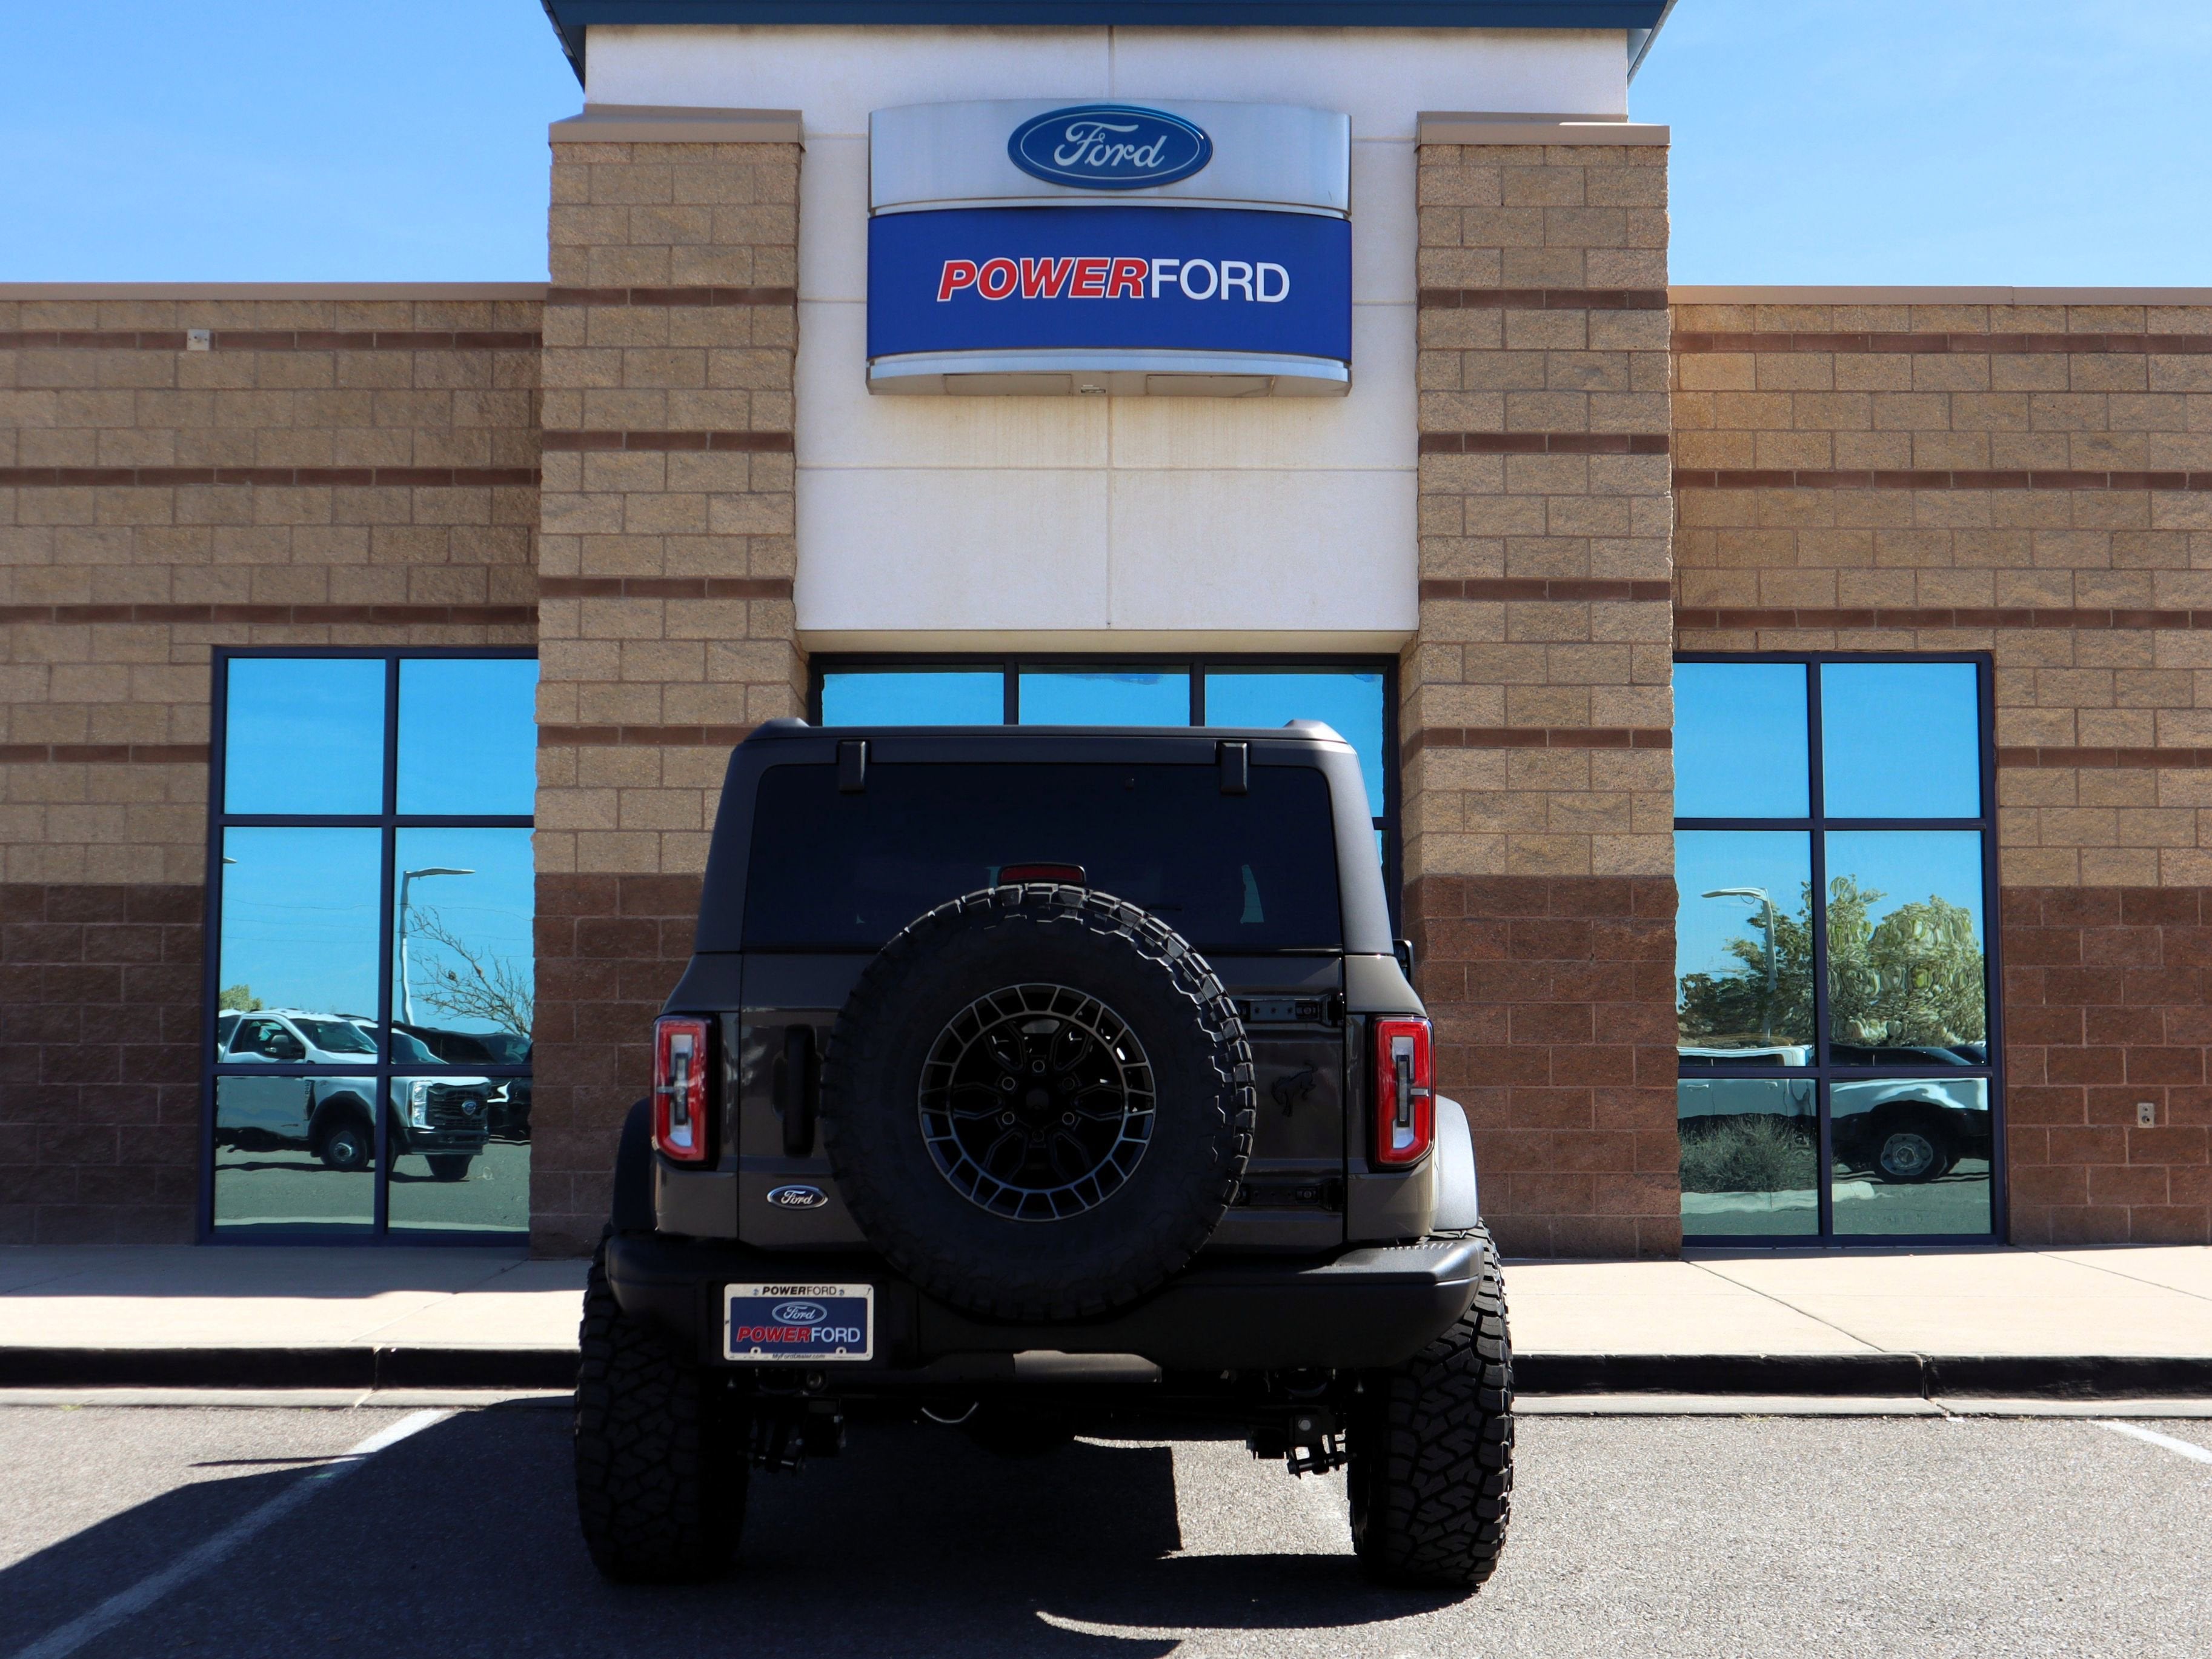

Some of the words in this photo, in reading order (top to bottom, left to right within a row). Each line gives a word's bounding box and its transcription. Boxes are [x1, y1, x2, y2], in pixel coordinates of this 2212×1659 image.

[1053, 121, 1168, 168] Ford
[937, 256, 1290, 303] POWERFORD
[780, 1189, 814, 1205] Ford
[762, 1286, 837, 1295] POWERFORD
[783, 1305, 816, 1320] Ford
[736, 1326, 861, 1343] POWERFORD
